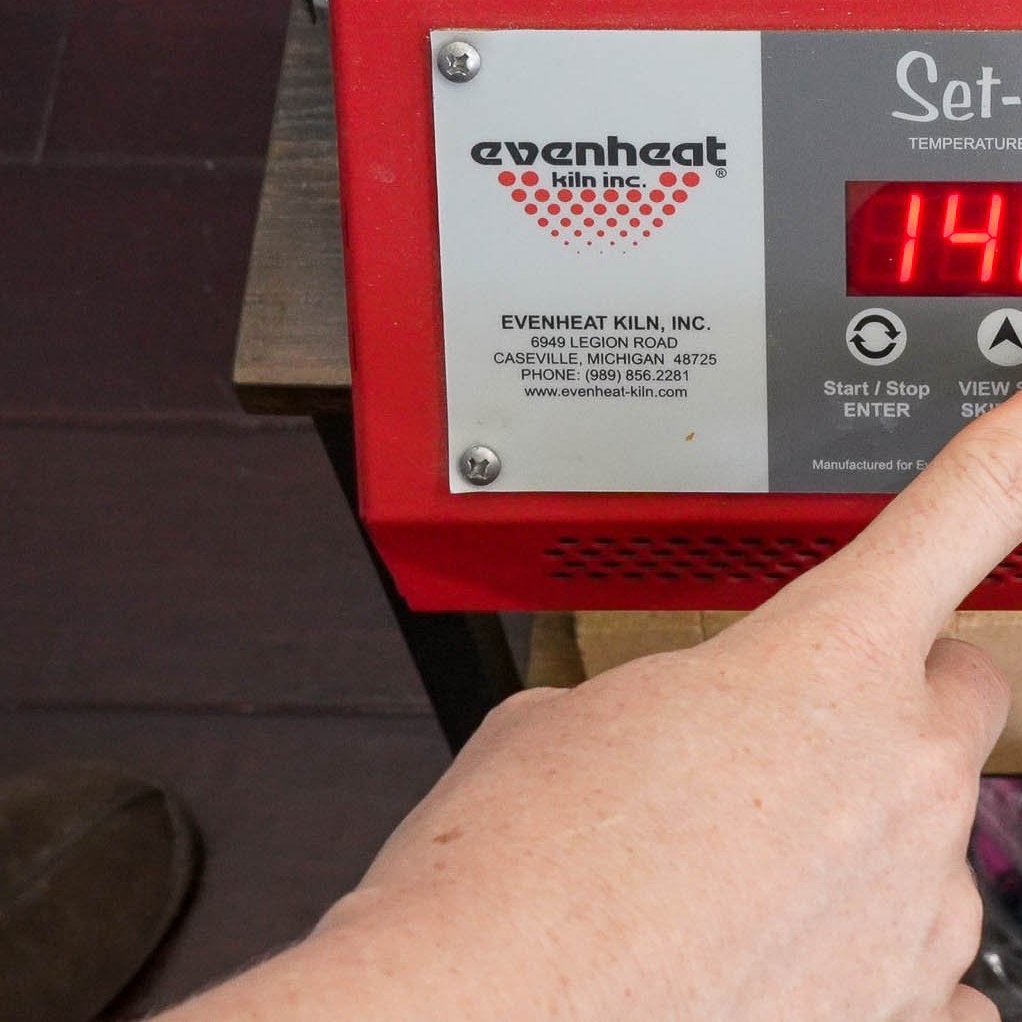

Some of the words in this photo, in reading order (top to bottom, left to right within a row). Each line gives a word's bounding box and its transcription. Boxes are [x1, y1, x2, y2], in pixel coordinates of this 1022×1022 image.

[470, 135, 727, 167] evenheat
[551, 171, 597, 188] kiln
[602, 171, 647, 188] inc.
[501, 314, 607, 330] EVENHEAT
[614, 315, 666, 333] KILN,
[671, 315, 711, 331] INC.
[530, 336, 567, 349] 6949
[570, 336, 629, 349] LEGION
[633, 336, 679, 349] ROAD
[493, 352, 583, 366] CASEVILLE,
[587, 353, 665, 366] MICHIGAN
[673, 353, 718, 366] 48725
[521, 368, 581, 382] PHONE:
[585, 369, 622, 384] (989)
[625, 369, 690, 382] 856.2281
[524, 385, 688, 398] www.evenheat-kiln.com
[823, 380, 870, 396] Start
[886, 380, 931, 400] Stop
[958, 381, 1011, 396] VIEW
[843, 401, 912, 418] ENTER
[812, 458, 894, 471] Manufactured
[896, 458, 913, 471] for
